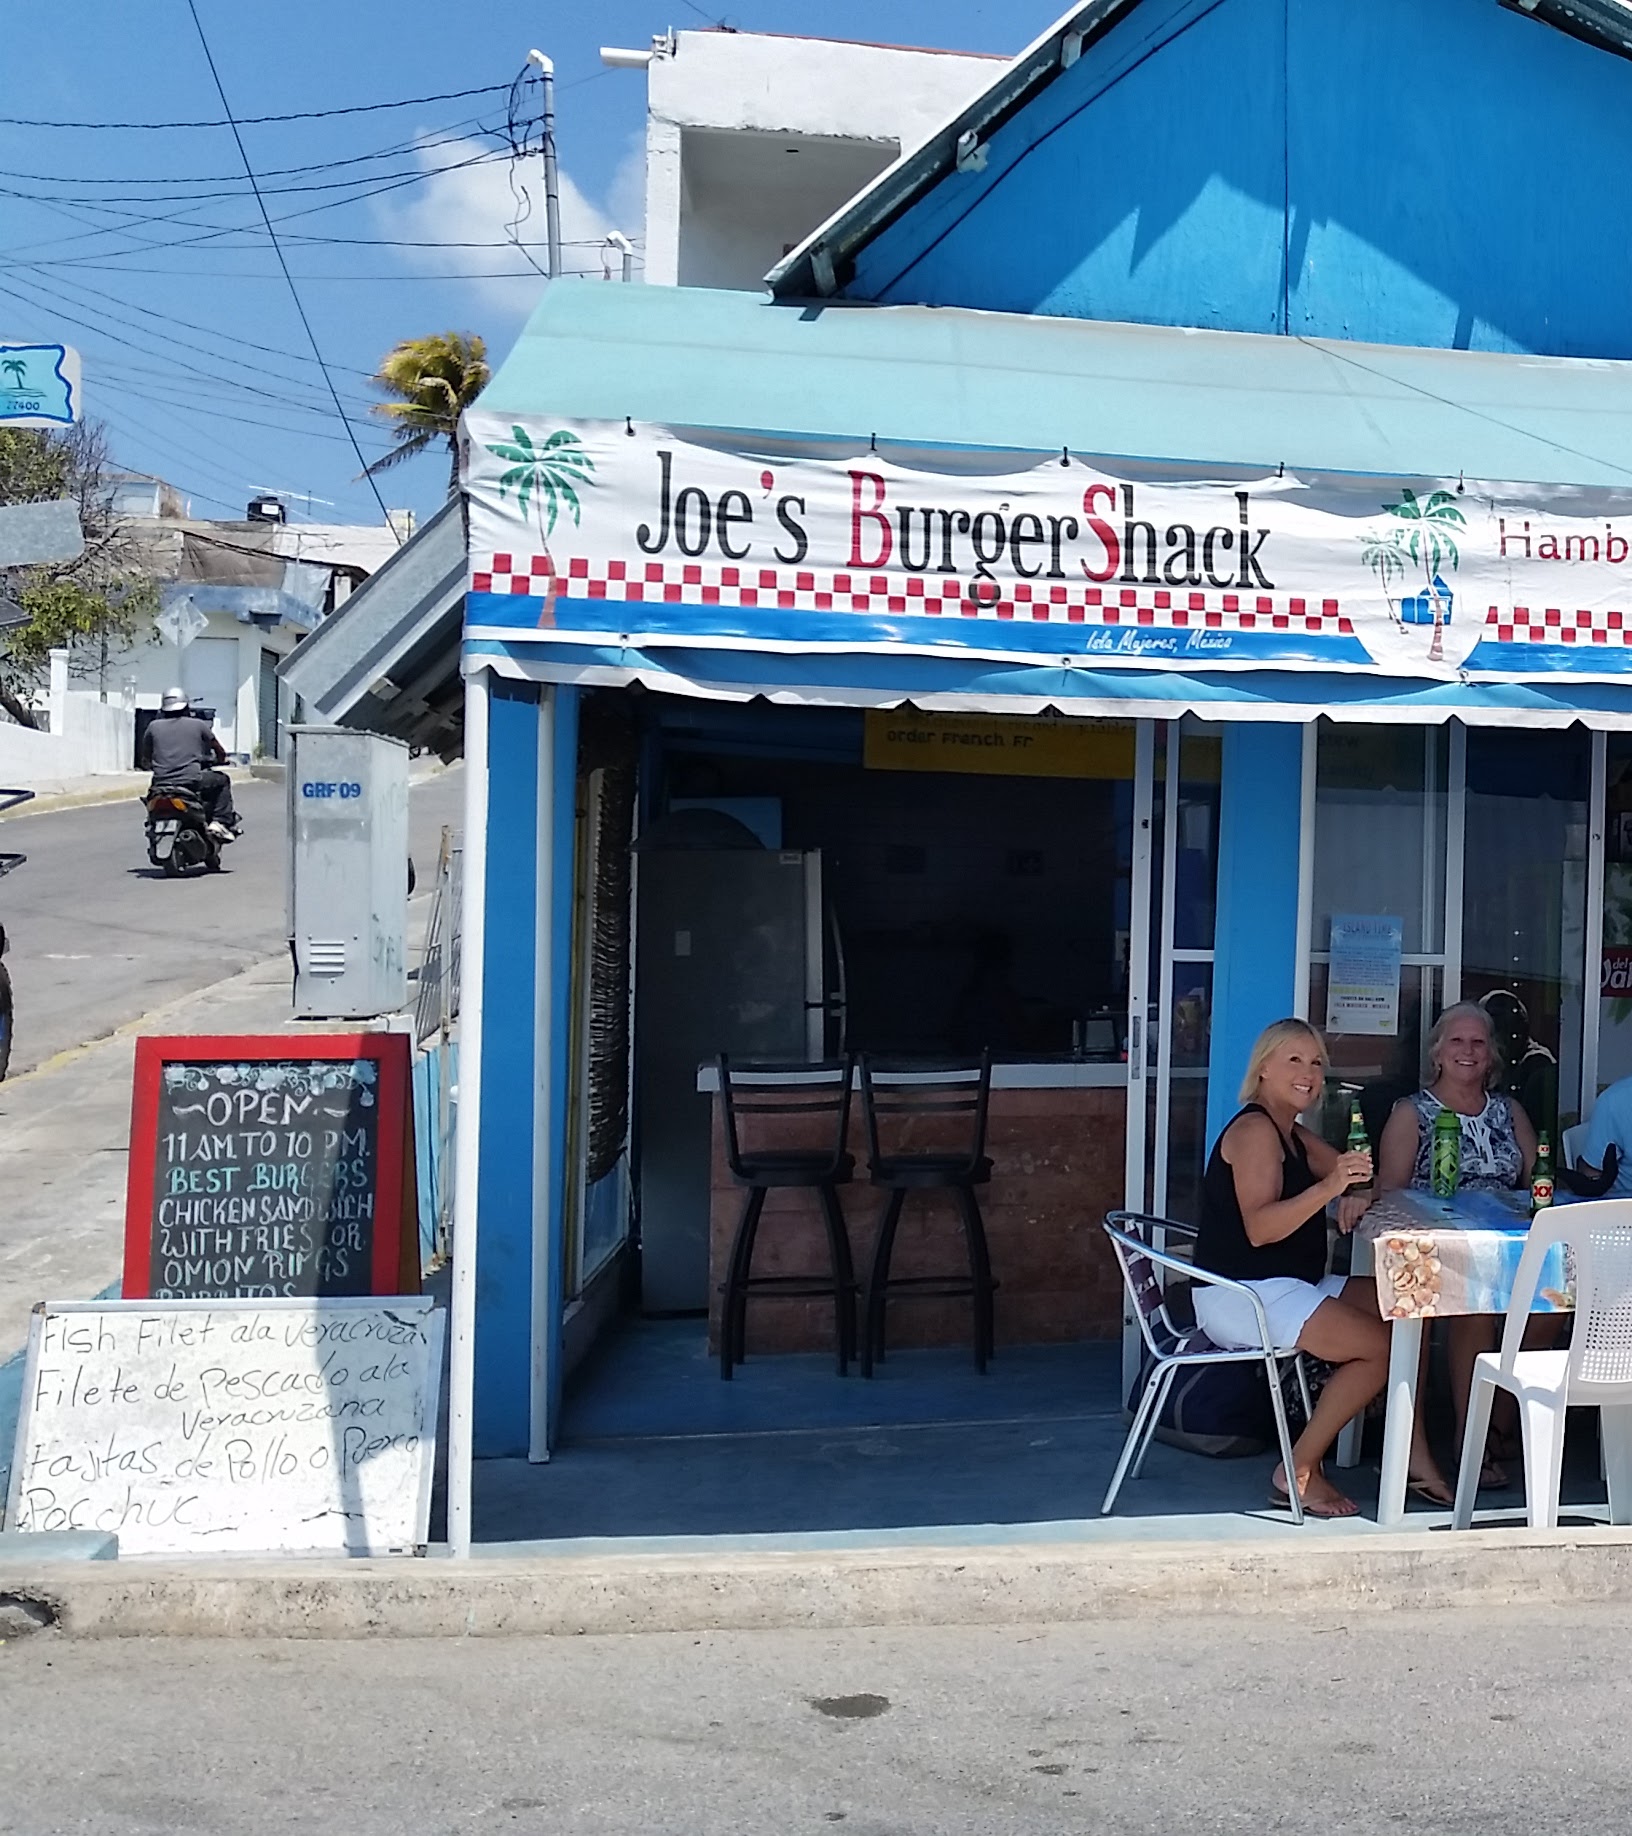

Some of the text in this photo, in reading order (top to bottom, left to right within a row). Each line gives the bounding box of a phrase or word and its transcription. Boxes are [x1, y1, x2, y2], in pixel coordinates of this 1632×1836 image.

[636, 450, 1276, 610] Joe's BurgerShack
[1086, 630, 1114, 650] Isla
[302, 782, 362, 799] GRF 09
[1612, 957, 1629, 970] del
[206, 1089, 313, 1127] OPEN
[284, 1131, 313, 1159] 10
[165, 1158, 369, 1197] BEST BURGERS
[158, 1192, 374, 1228] CHICKEN SANDWICH
[160, 1228, 233, 1259] WITH
[236, 1223, 314, 1254] FRIES
[164, 1247, 350, 1288] ONION RINGS
[44, 1314, 116, 1354] Fish
[137, 1313, 215, 1355] Filet
[35, 1365, 141, 1412] Filete
[154, 1363, 189, 1402] de
[199, 1350, 350, 1410] Pescado
[175, 1432, 214, 1479] de
[224, 1432, 298, 1485] Pollo
